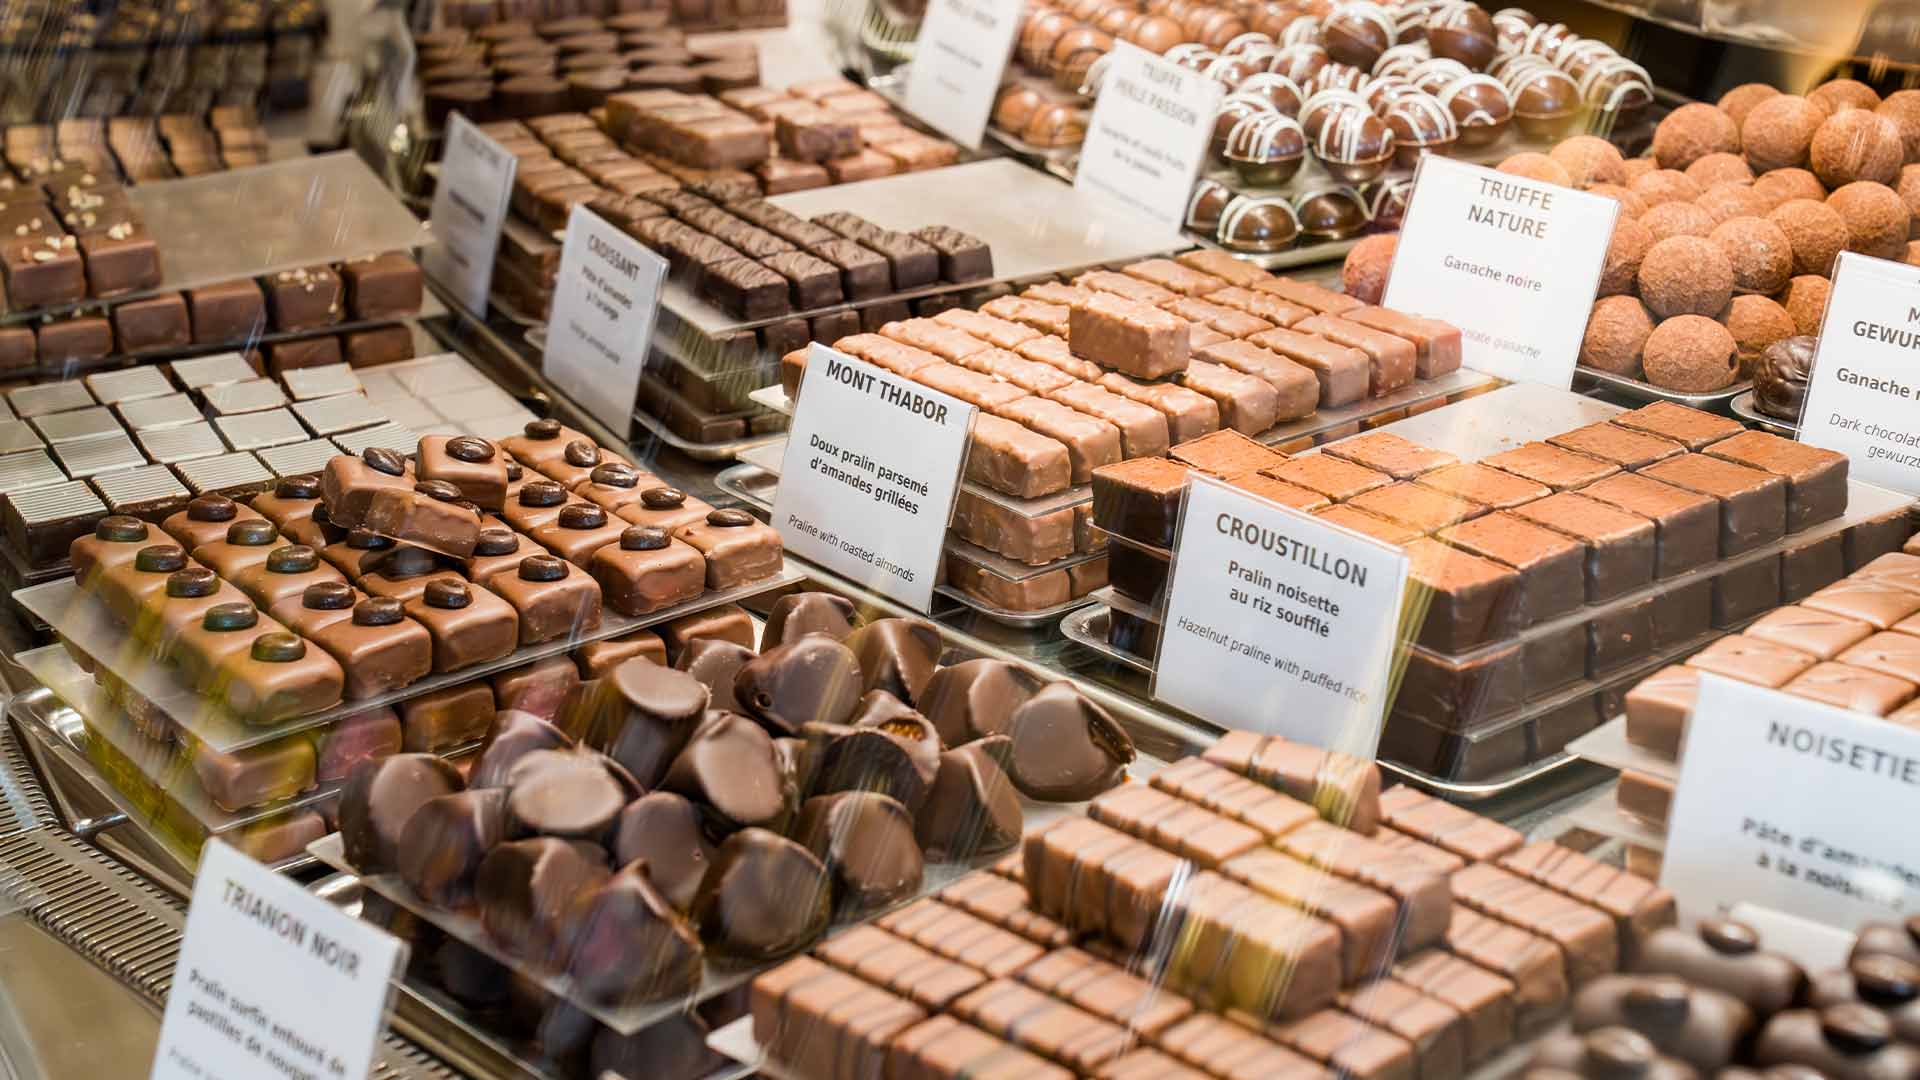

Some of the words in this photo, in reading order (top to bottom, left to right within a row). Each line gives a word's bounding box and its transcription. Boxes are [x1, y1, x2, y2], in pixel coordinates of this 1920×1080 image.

[1479, 177, 1553, 210] TRUFFE
[1467, 205, 1548, 239] NATURE
[587, 234, 640, 281] CROISSANT
[1444, 255, 1502, 281] Ganache
[1505, 274, 1542, 292] noire
[826, 359, 876, 394] MONT
[880, 380, 948, 425] THABOR
[1837, 367, 1910, 399] Ganache
[1829, 412, 1861, 432] Dark
[810, 433, 839, 457] Doux
[841, 447, 875, 473] pralin
[877, 465, 928, 497] parsemé
[874, 486, 919, 515] grillées
[788, 514, 818, 537] Praline
[819, 530, 838, 547] with
[840, 539, 874, 563] roasted
[875, 556, 915, 583] almonds
[1216, 513, 1368, 587] CROUSTILLON
[1228, 560, 1272, 590] Pralin
[1276, 582, 1340, 616] noisette
[1230, 587, 1248, 605] au
[1252, 596, 1272, 615] riz
[1276, 609, 1330, 638] soufflé
[1177, 616, 1229, 647] Hazelnut
[1230, 638, 1272, 664] praline
[1274, 656, 1300, 676] with
[1301, 669, 1342, 694] puffed
[1345, 685, 1369, 705] rice
[1768, 720, 1920, 785] NOISETIE
[1742, 817, 1793, 847] Pâte
[1778, 857, 1798, 878] la
[223, 878, 308, 946] TRIANON
[310, 931, 360, 980] NOIR
[188, 968, 227, 1002] Pralin
[329, 1055, 346, 1076] de
[245, 1035, 262, 1057] de
